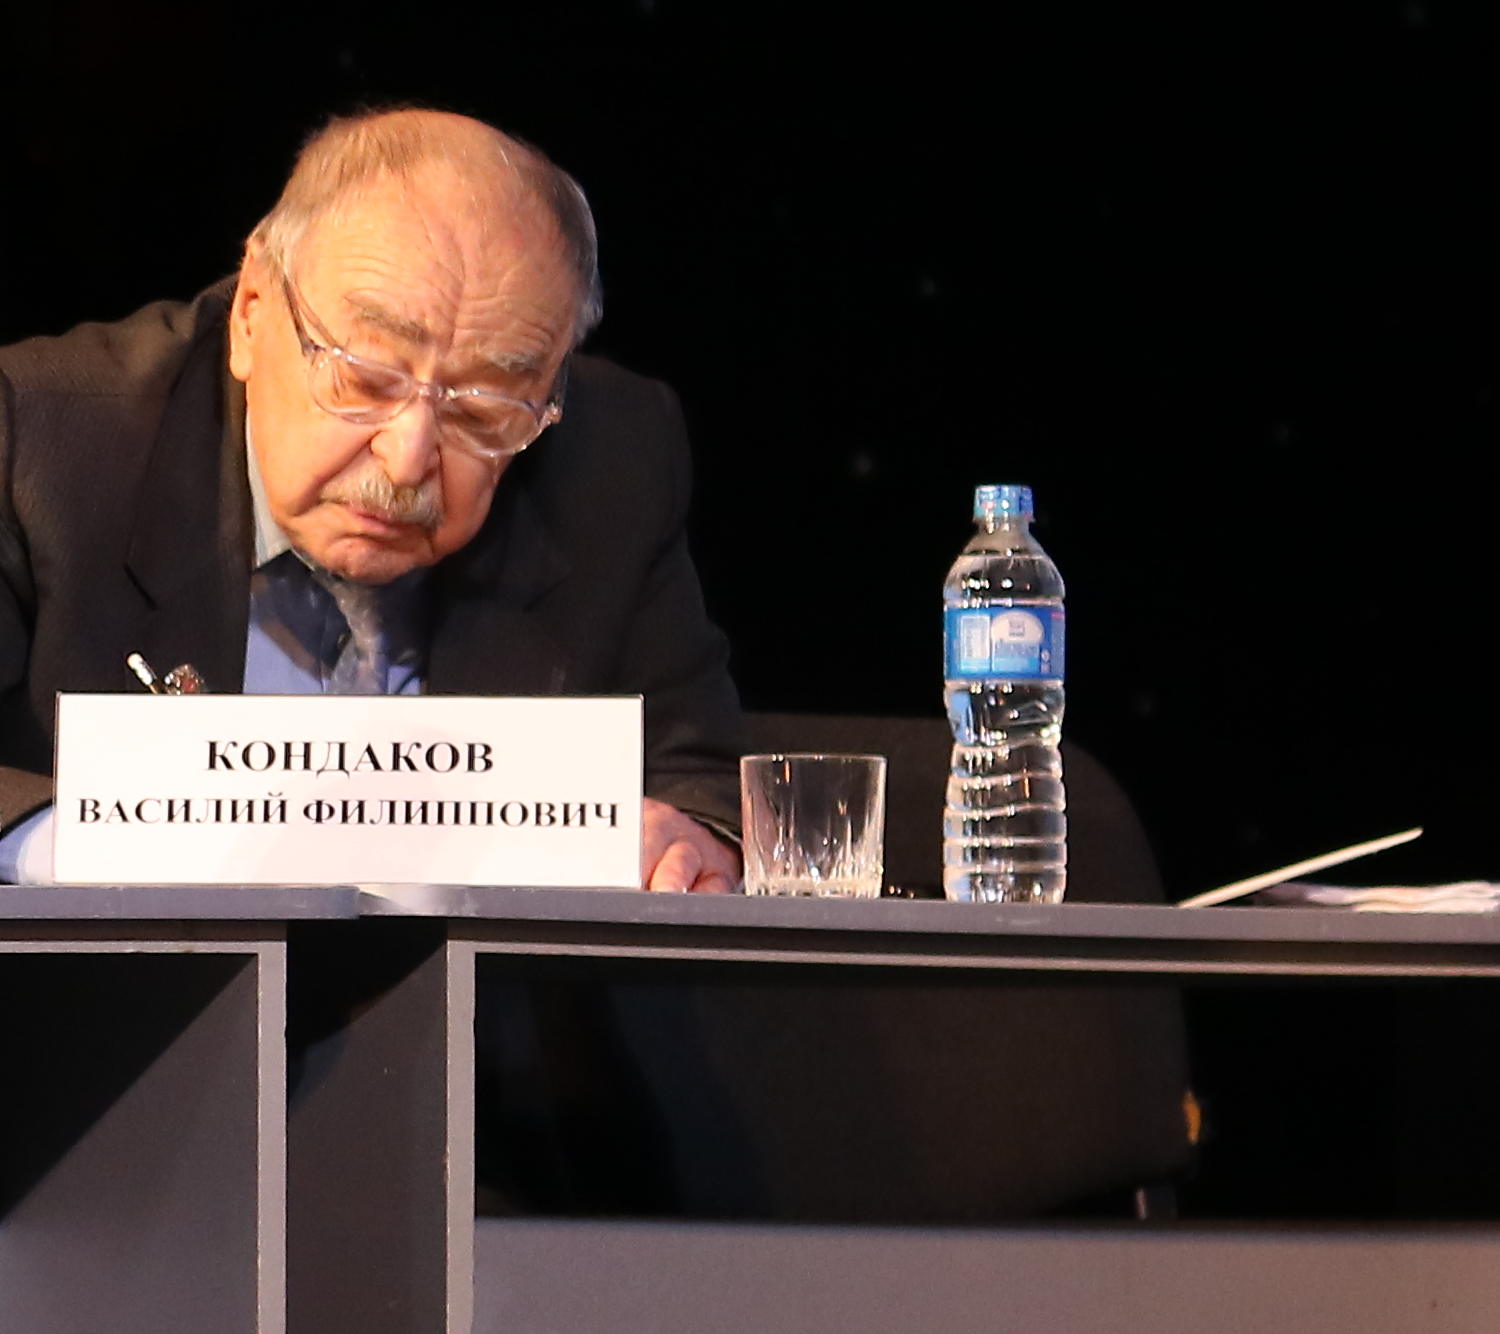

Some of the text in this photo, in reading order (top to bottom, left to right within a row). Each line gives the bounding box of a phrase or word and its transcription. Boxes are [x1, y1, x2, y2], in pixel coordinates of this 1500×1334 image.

[206, 740, 495, 778] КОНДАКОВ
[78, 791, 619, 829] ВАСИЛИЙ ФИЛИППОВИЧ
